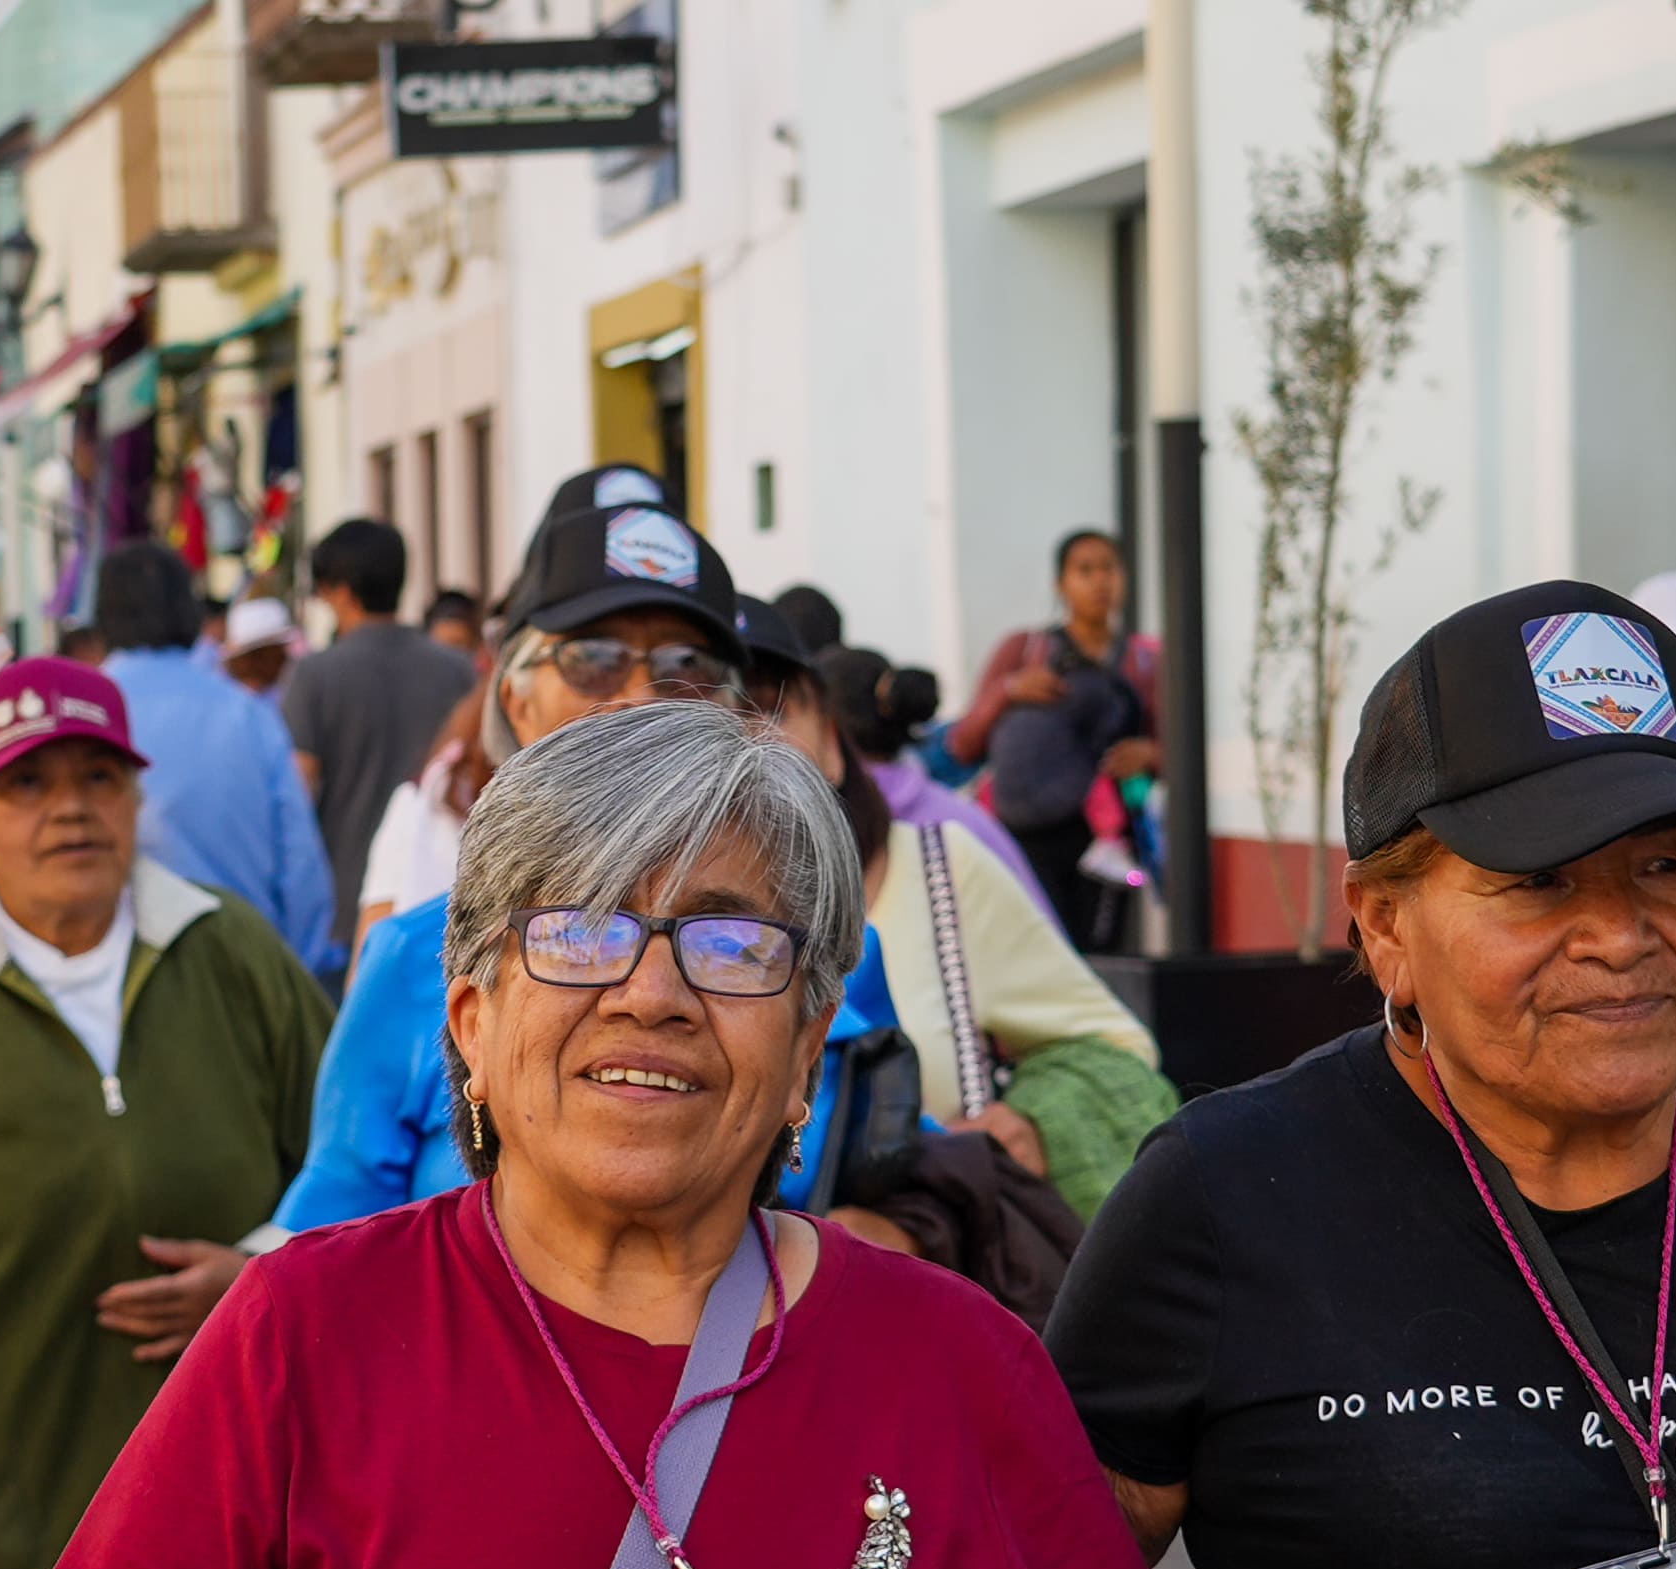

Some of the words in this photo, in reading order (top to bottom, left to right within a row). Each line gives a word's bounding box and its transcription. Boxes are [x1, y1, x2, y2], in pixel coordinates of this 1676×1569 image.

[398, 64, 659, 115] CHAMPIONS
[1544, 667, 1661, 689] TLAXCALA
[1318, 1394, 1365, 1421] DO
[1386, 1385, 1497, 1414] MORE
[1518, 1386, 1564, 1410] OF
